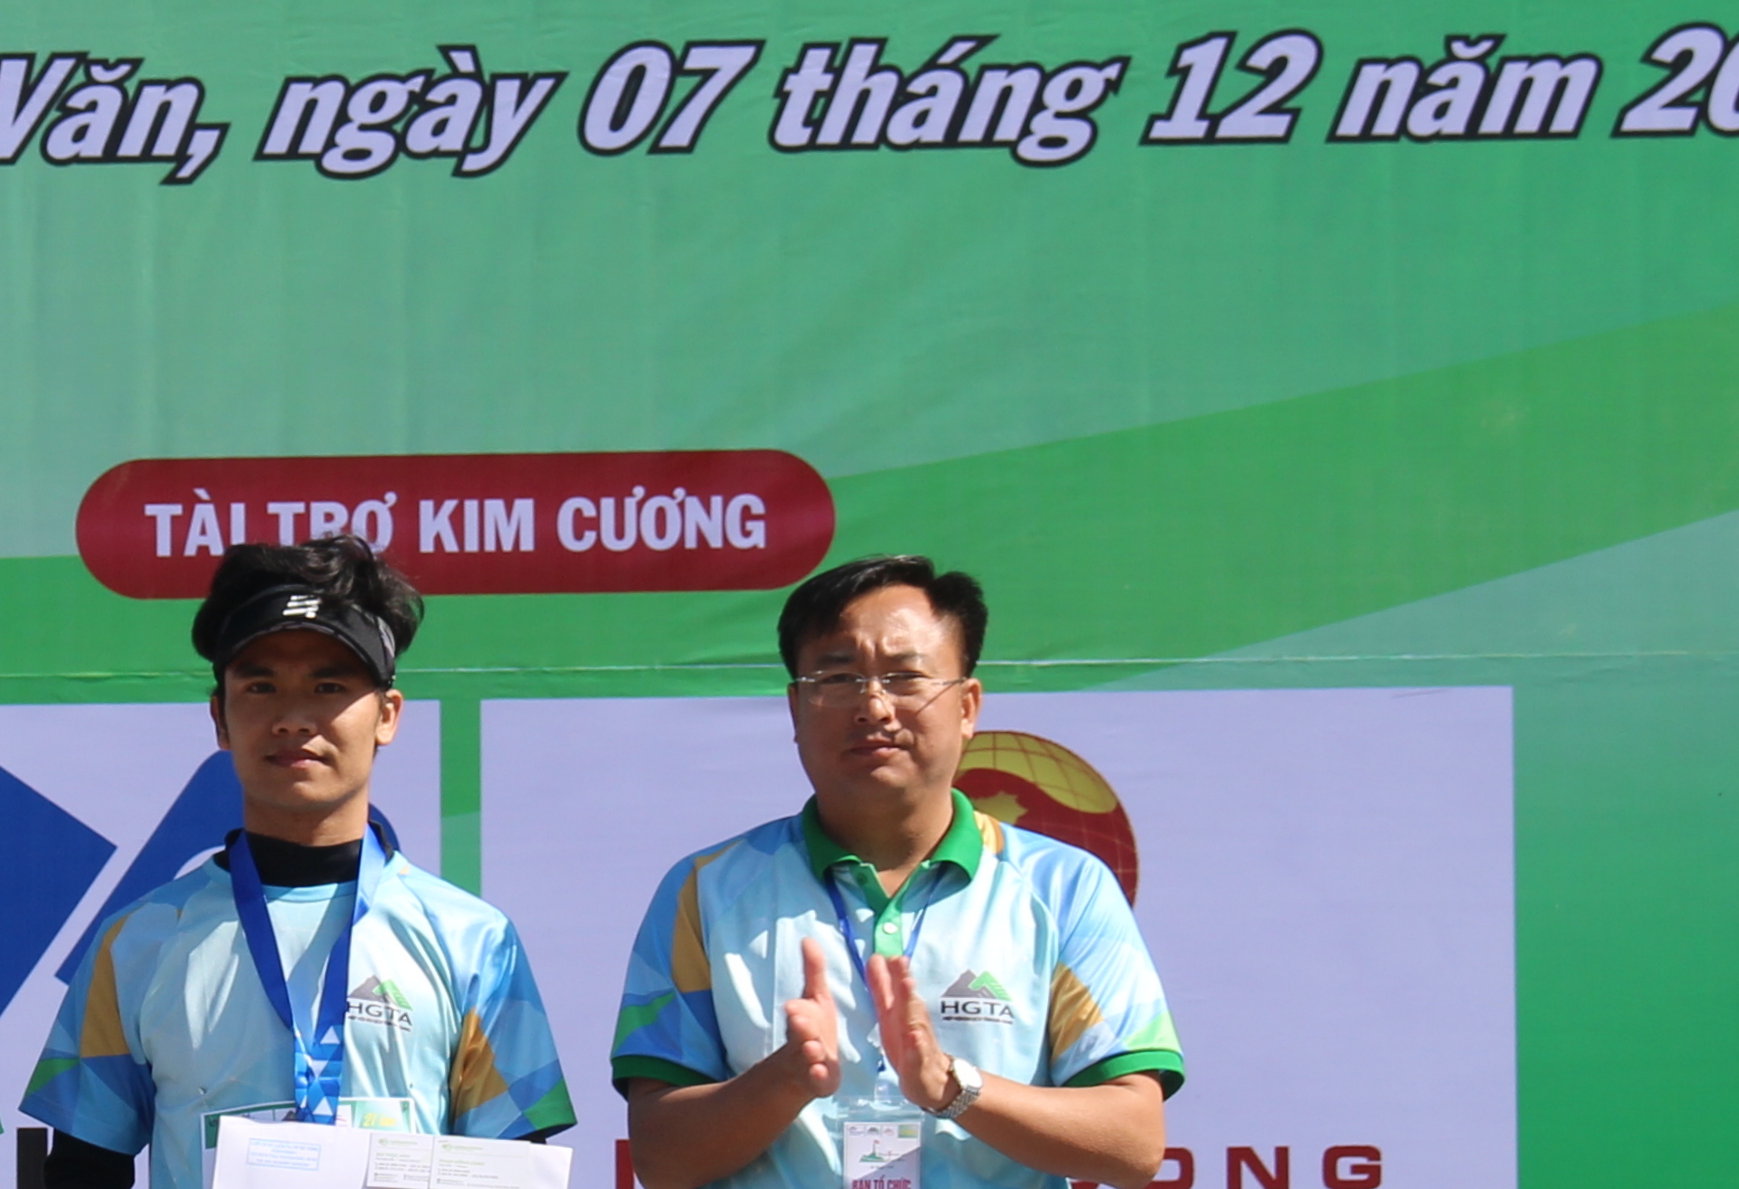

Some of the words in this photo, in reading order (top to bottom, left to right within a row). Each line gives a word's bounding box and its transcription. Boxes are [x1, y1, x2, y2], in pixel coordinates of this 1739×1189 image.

[254, 45, 567, 179] ngày
[577, 39, 764, 154] 07
[767, 33, 1129, 167] tháng
[1139, 28, 1325, 145] 12
[1326, 34, 1603, 143] năm
[144, 488, 246, 557] TÀI
[419, 498, 535, 553] KIM
[557, 485, 766, 552] CƯƠNG
[347, 1001, 413, 1026] HGTA
[941, 1000, 1015, 1019] HGTA
